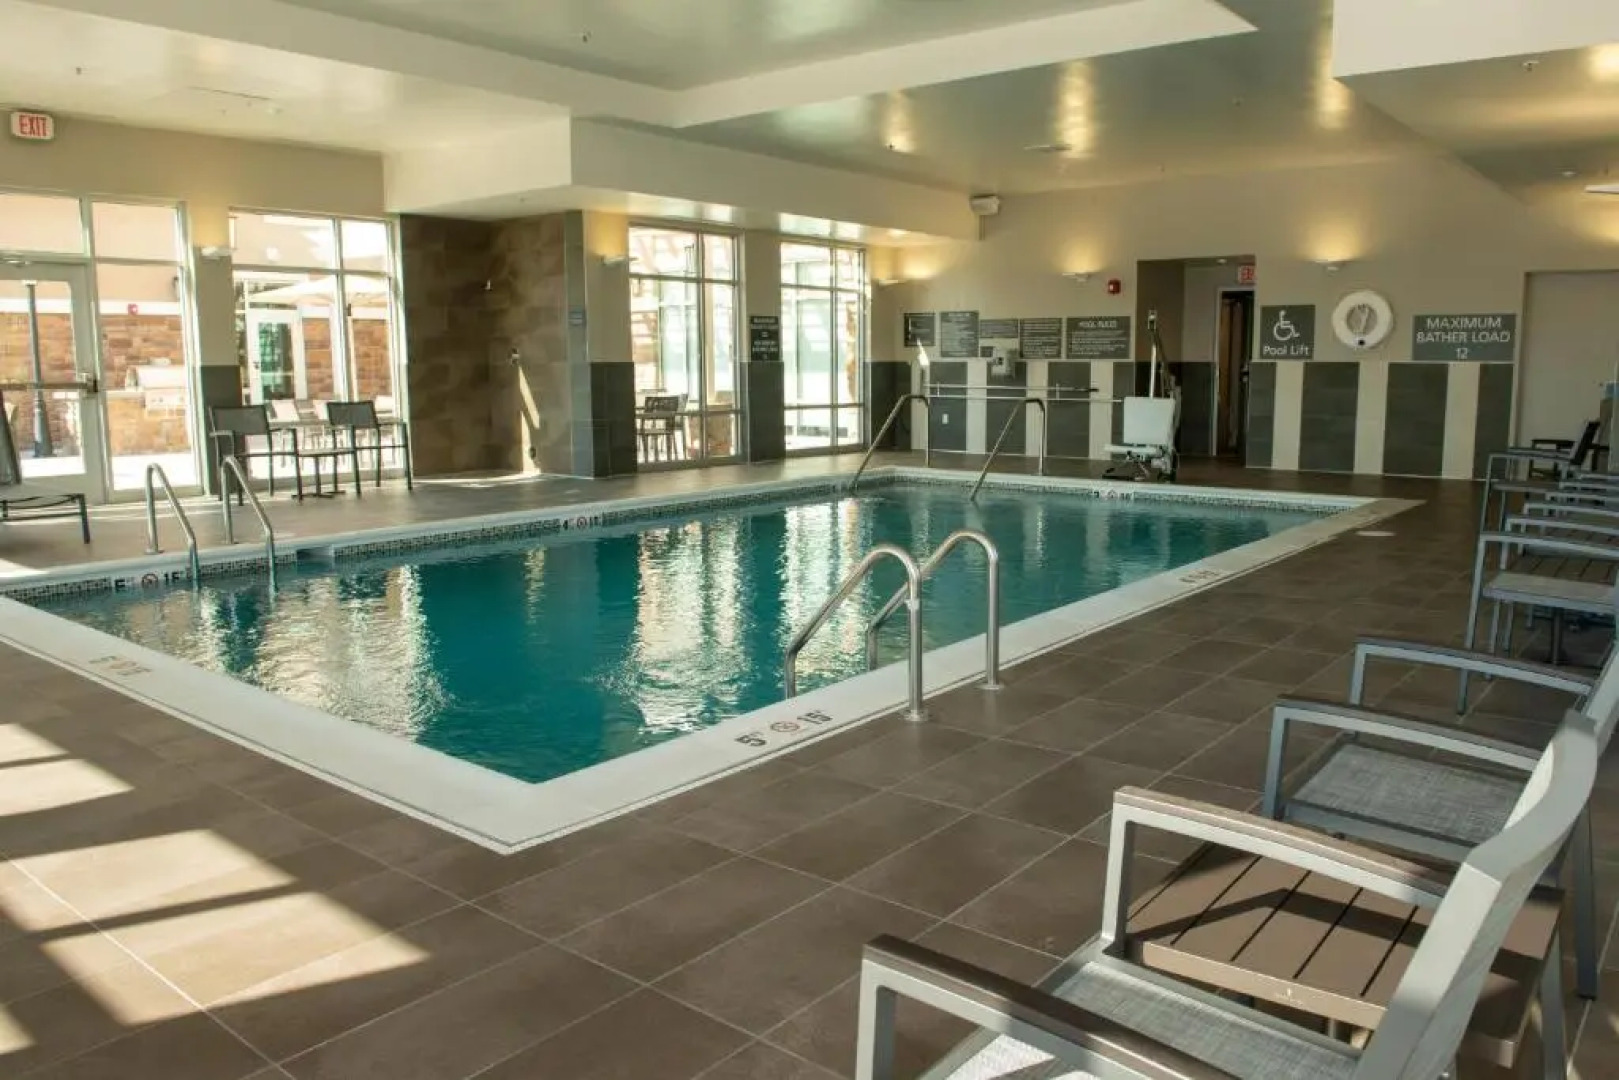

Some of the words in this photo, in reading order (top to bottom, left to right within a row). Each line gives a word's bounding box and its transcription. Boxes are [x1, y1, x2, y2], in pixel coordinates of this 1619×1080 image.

[19, 114, 47, 137] EXIT
[1426, 317, 1502, 329] MAXIMUM
[1416, 331, 1468, 343] BATHER
[1471, 331, 1510, 343] LOAD
[1263, 345, 1287, 355] Pool
[1290, 345, 1309, 355] Lift
[1456, 347, 1468, 360] 12
